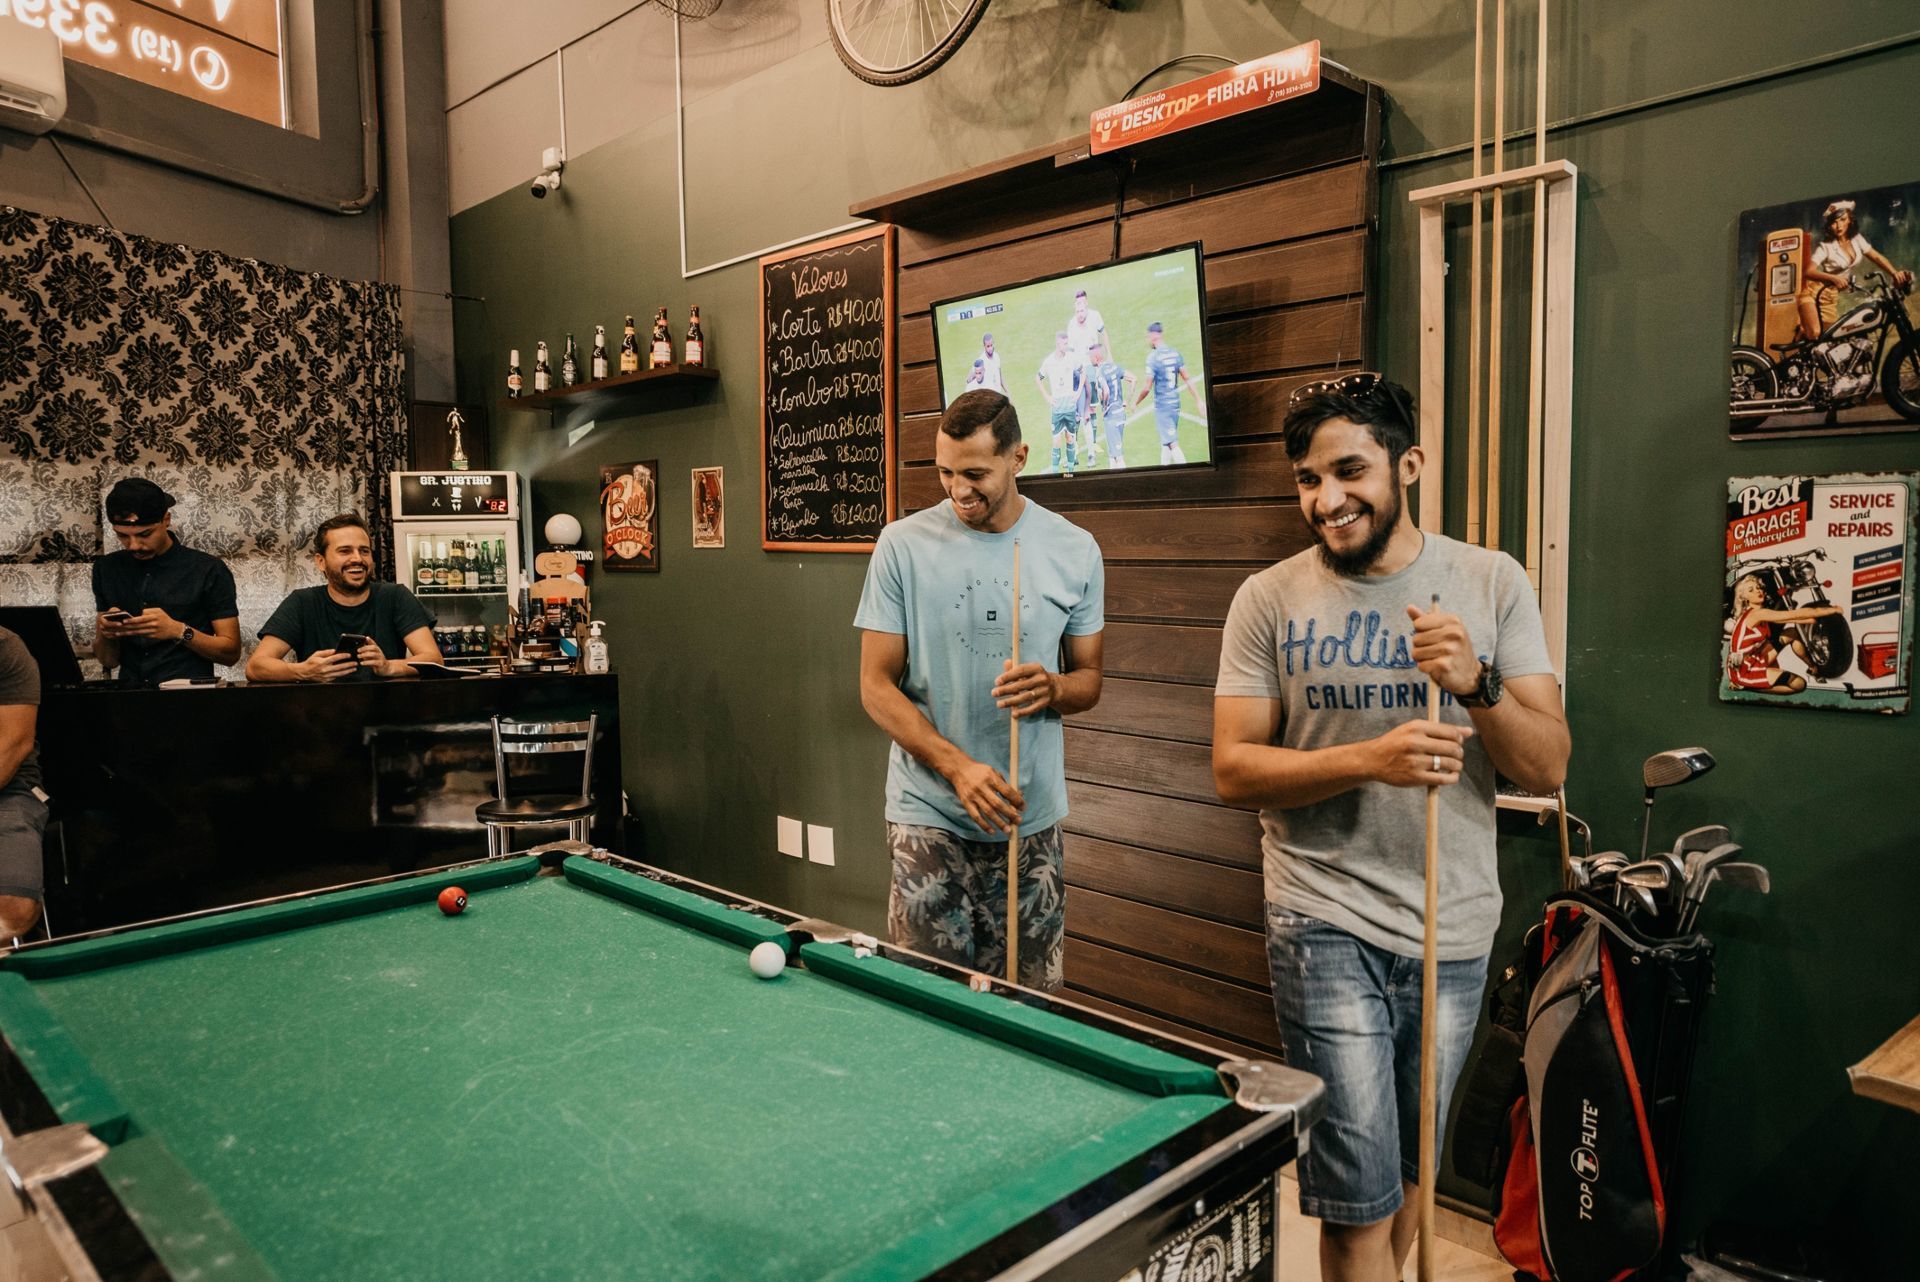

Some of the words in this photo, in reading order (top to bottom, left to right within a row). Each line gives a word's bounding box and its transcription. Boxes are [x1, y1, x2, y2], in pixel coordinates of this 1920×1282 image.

[1121, 93, 1200, 132] DESKTOP
[1207, 76, 1259, 106] FIBRA
[1263, 55, 1313, 90] HDTV
[791, 265, 848, 299] Valores
[777, 307, 822, 341] Corte
[780, 340, 836, 377] Barba
[776, 375, 834, 414] Combo
[441, 475, 492, 486] JUSTINO
[1737, 477, 1802, 517] Best
[1829, 492, 1896, 509] SERVICE
[1850, 508, 1871, 521] and
[606, 527, 648, 545] O'CLOCK
[1733, 507, 1801, 540] GARAGE
[1743, 526, 1800, 549] Motorcycles
[1827, 522, 1894, 538] REPAIRS
[993, 578, 1030, 610] LOSE
[1280, 610, 1488, 676] Hollis
[1306, 682, 1453, 710] CALIFORNA
[1580, 1182, 1593, 1221] TOP
